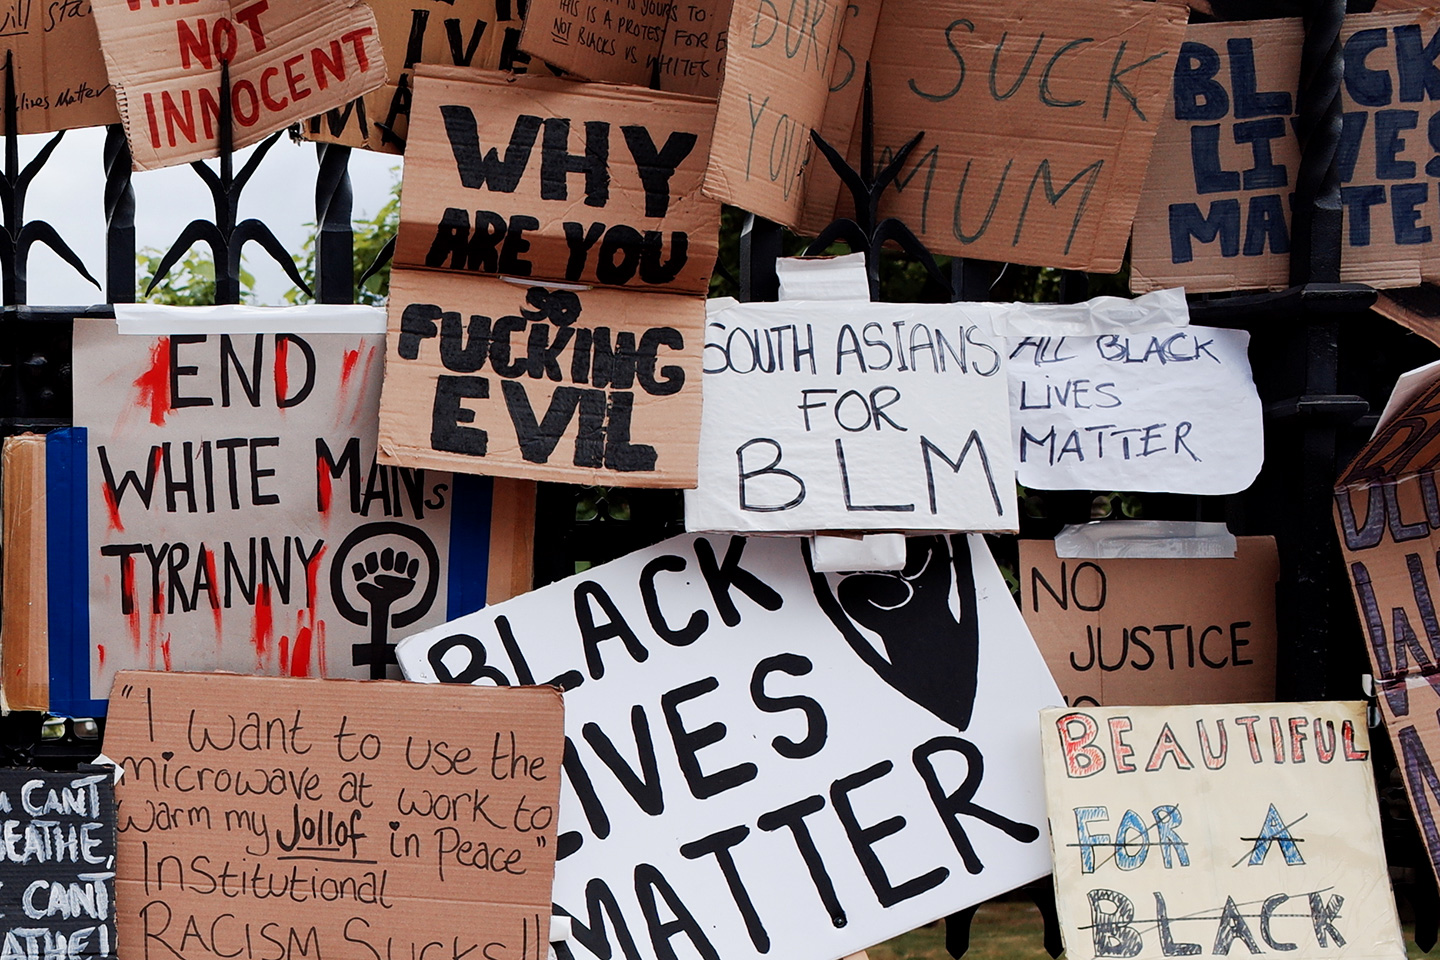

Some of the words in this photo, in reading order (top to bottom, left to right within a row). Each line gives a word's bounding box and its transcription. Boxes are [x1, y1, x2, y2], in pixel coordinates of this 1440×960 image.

[554, 18, 572, 35] NOT
[439, 104, 698, 218] WHY
[425, 208, 540, 277] ARE
[563, 220, 689, 286] YOU
[520, 285, 582, 327] SO
[397, 302, 685, 396] FUCKING
[703, 322, 817, 376] SOUTH
[836, 320, 1001, 378] ASIANS
[430, 374, 658, 472] EVIL
[798, 385, 908, 432] FOR
[334, 715, 382, 762] to
[491, 731, 547, 781] the
[1055, 712, 1370, 778] BEAUTIFUL
[119, 751, 321, 796] microwave
[338, 771, 374, 807] at
[514, 794, 553, 833] to
[225, 807, 270, 856] my
[275, 809, 363, 859] Jollof
[389, 821, 419, 859] in
[1072, 804, 1191, 875] FOR
[1248, 803, 1306, 866] A
[1086, 888, 1347, 959] BLACK
